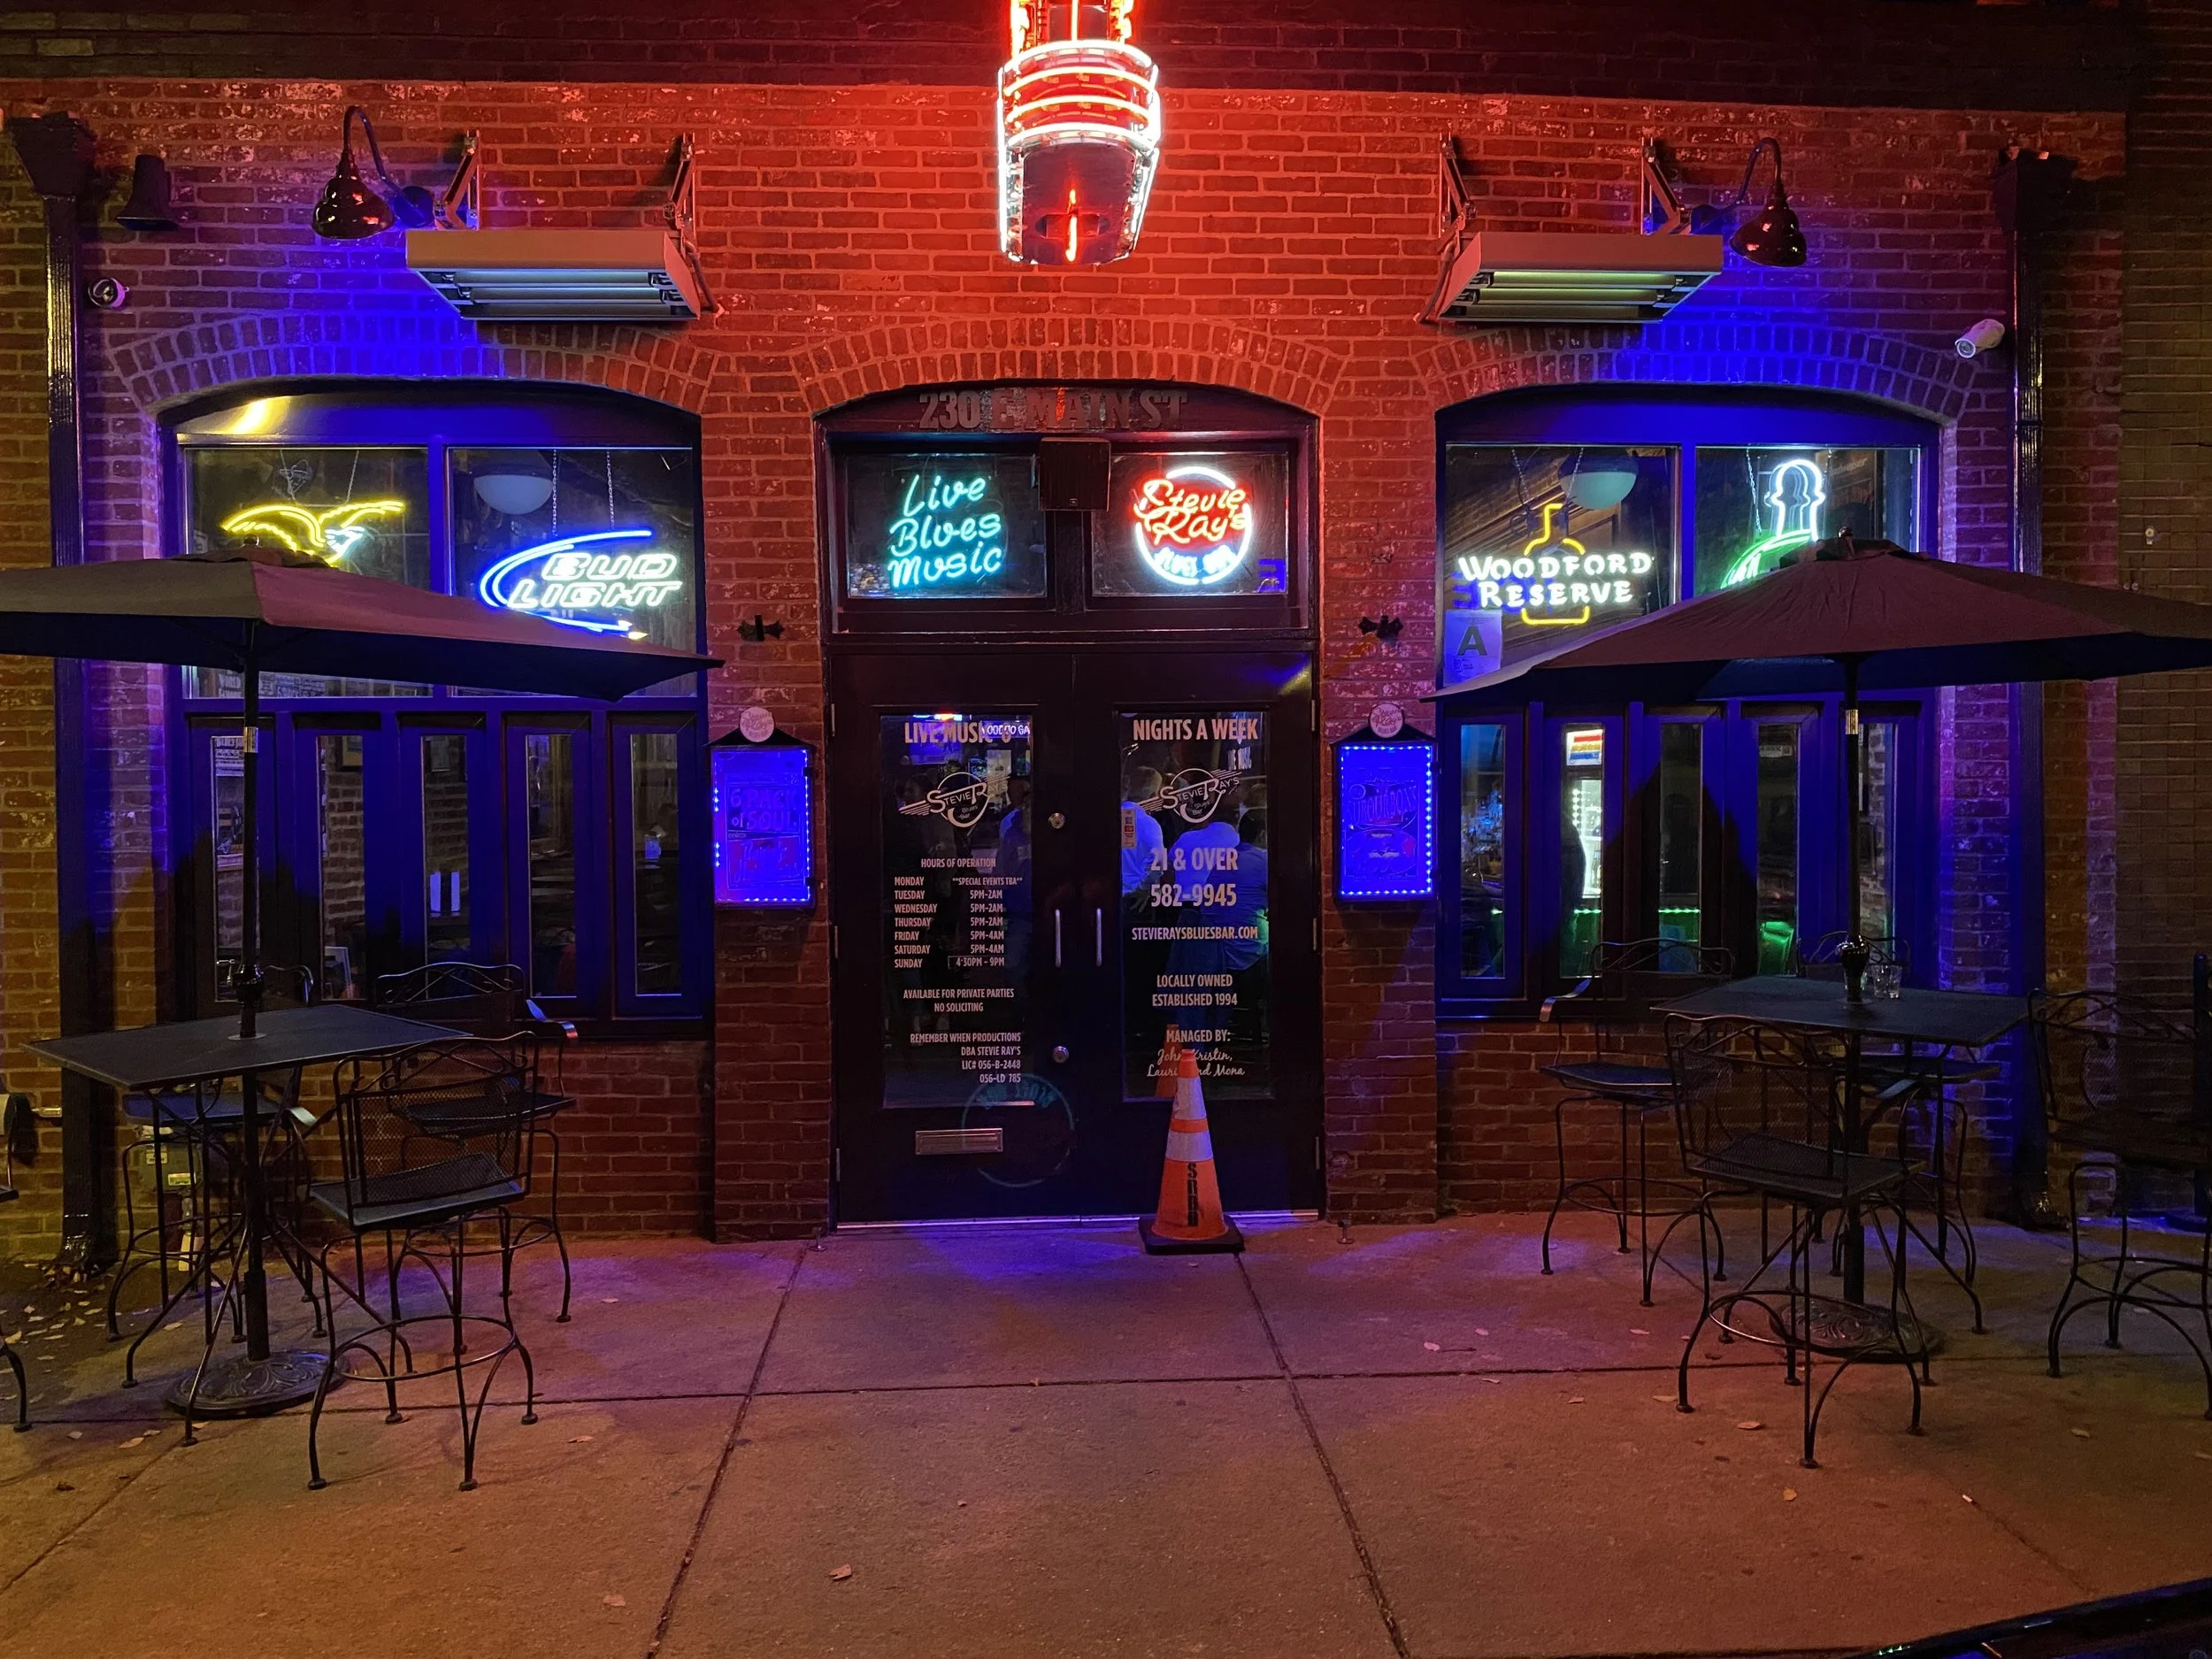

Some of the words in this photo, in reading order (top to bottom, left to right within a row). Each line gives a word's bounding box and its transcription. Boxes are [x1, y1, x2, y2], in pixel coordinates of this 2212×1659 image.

[918, 389, 980, 429] 230
[988, 388, 1014, 430] E
[1024, 388, 1133, 430] MAIN
[1138, 388, 1188, 430] ST
[903, 474, 986, 517] Live
[1141, 479, 1247, 513] Stevie
[889, 513, 1002, 557] Blues
[541, 552, 678, 580] BUD
[887, 541, 1002, 588] Music
[1458, 551, 1654, 581] WOODFORD
[506, 579, 683, 609] LIGHT
[1478, 580, 1633, 609] RESERVE
[1456, 626, 1488, 657] A
[904, 722, 938, 744] LIVE
[944, 722, 994, 744] MUSIC
[1133, 718, 1193, 741] NIGHTS
[1196, 718, 1208, 740] A
[1211, 718, 1258, 740] WEEK
[730, 788, 741, 807] 6
[926, 789, 972, 813] STEVIE
[1160, 786, 1204, 809] STEVIE
[731, 811, 744, 828] of
[746, 810, 796, 831] SOUL
[921, 858, 945, 868] HOURS
[947, 858, 956, 867] OF
[956, 857, 996, 867] OPERATION
[1150, 848, 1168, 871] 21
[1173, 848, 1187, 871] &
[1192, 847, 1239, 871] OVER
[894, 877, 924, 886] MONDAY
[982, 877, 1004, 886] EVENTS
[894, 890, 925, 900] TUESDAY
[970, 890, 1002, 899] 5PM-2AM
[1150, 883, 1237, 907] 582-9945
[894, 903, 938, 913] WEDNESDAY
[970, 903, 1003, 912] 5PM-2AM
[894, 918, 932, 927] THURSDAY
[970, 917, 1003, 926] 5PM-2AM
[894, 931, 919, 941] FRIDAY
[970, 931, 1004, 940] 5PM-4AM
[1132, 926, 1258, 941] STEVIERAYSBLUESBAR.COM
[894, 945, 931, 955] SATURDAY
[970, 944, 1004, 954] 5PM-4AM
[894, 958, 923, 968] SUNDAY
[989, 957, 1005, 966] 9PM
[1156, 974, 1194, 987] LOCALLY
[1197, 974, 1233, 987] OWNED
[903, 989, 941, 999] AVAILABLE
[941, 989, 956, 998] FOR
[956, 988, 986, 998] PRIVATE
[987, 988, 1015, 998] PARTIES
[1152, 994, 1212, 1007] ESTABLISHED
[1215, 993, 1238, 1006] 1994
[934, 1002, 944, 1012] NO
[946, 1002, 984, 1012] SOLICITING
[910, 1033, 949, 1043] REMEMBER
[949, 1033, 971, 1042] WHEN
[972, 1033, 1021, 1042] PRODUCTIONS
[1166, 1029, 1212, 1042] MANAGED
[1215, 1029, 1231, 1042] BY:
[961, 1047, 975, 1056] DBA
[977, 1046, 999, 1056] STEVIE
[1001, 1046, 1021, 1056] RAY'S
[962, 1060, 977, 1070] LIC#
[978, 1060, 1021, 1070] 056-B-2448
[1213, 1063, 1246, 1077] Mona
